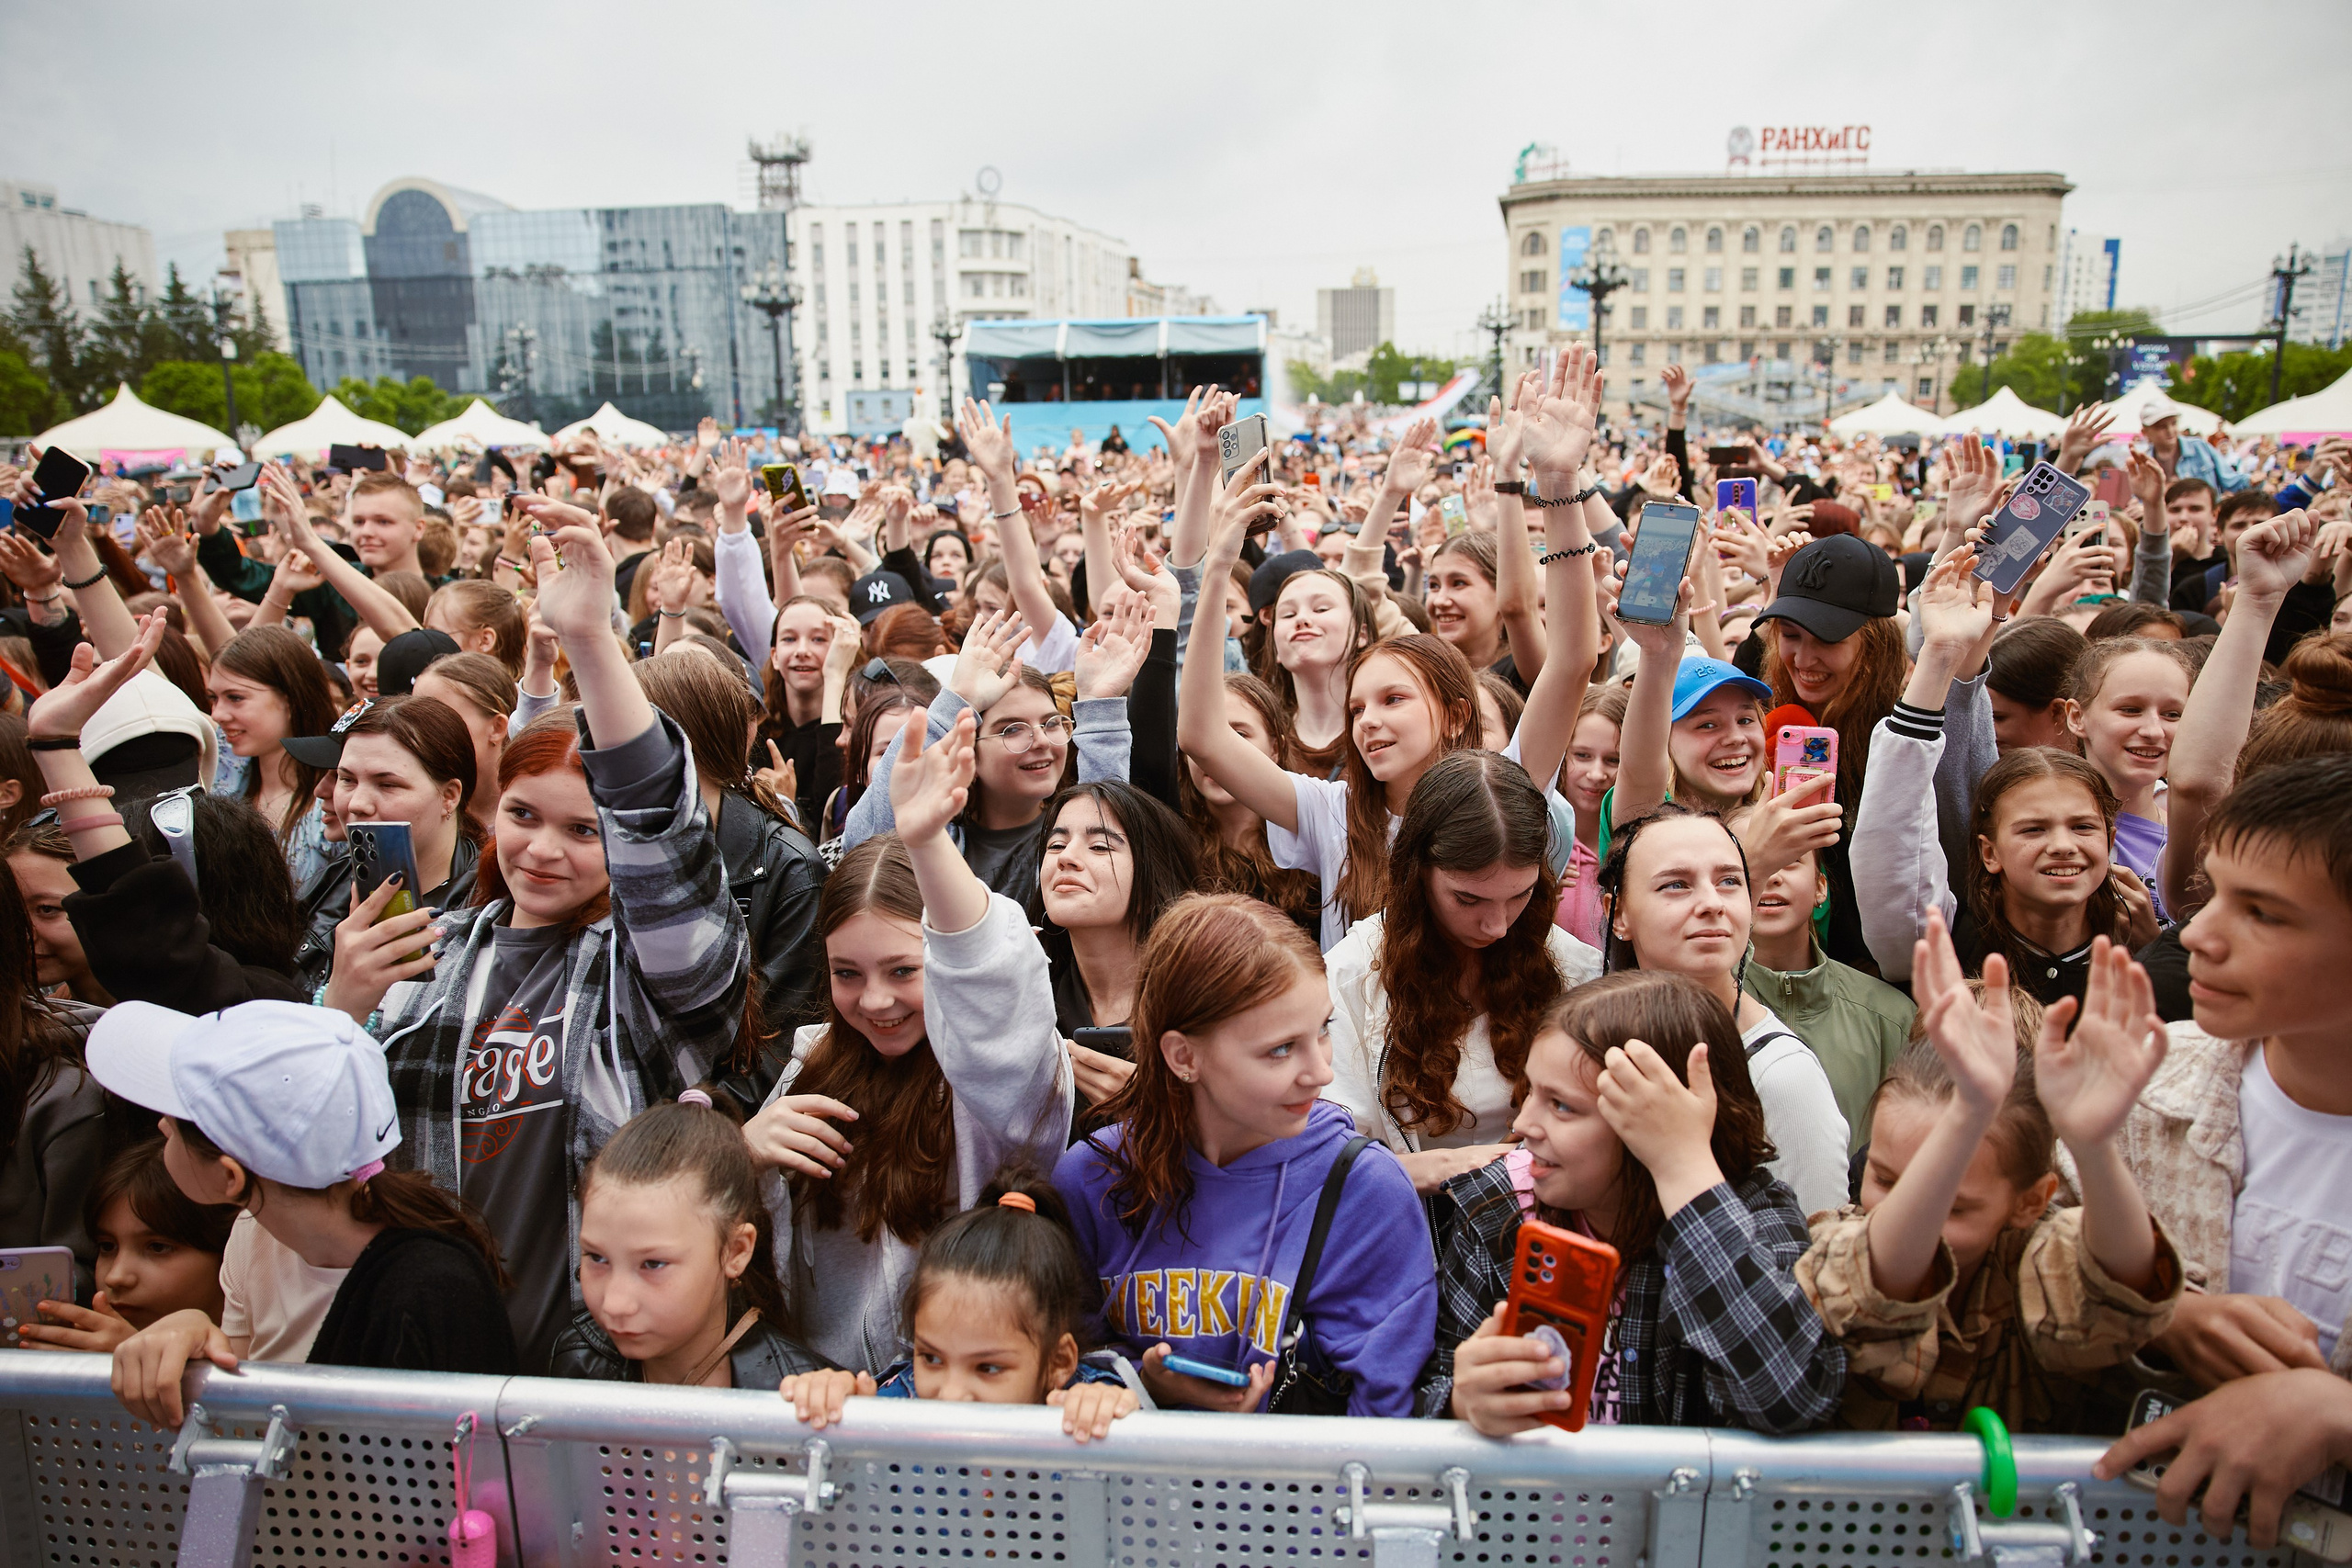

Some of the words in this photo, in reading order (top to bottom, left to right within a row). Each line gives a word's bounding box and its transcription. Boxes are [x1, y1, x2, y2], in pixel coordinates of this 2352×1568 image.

[1761, 126, 1871, 151] РАНХиГС
[867, 580, 891, 603] NY
[402, 893, 414, 911] VISA
